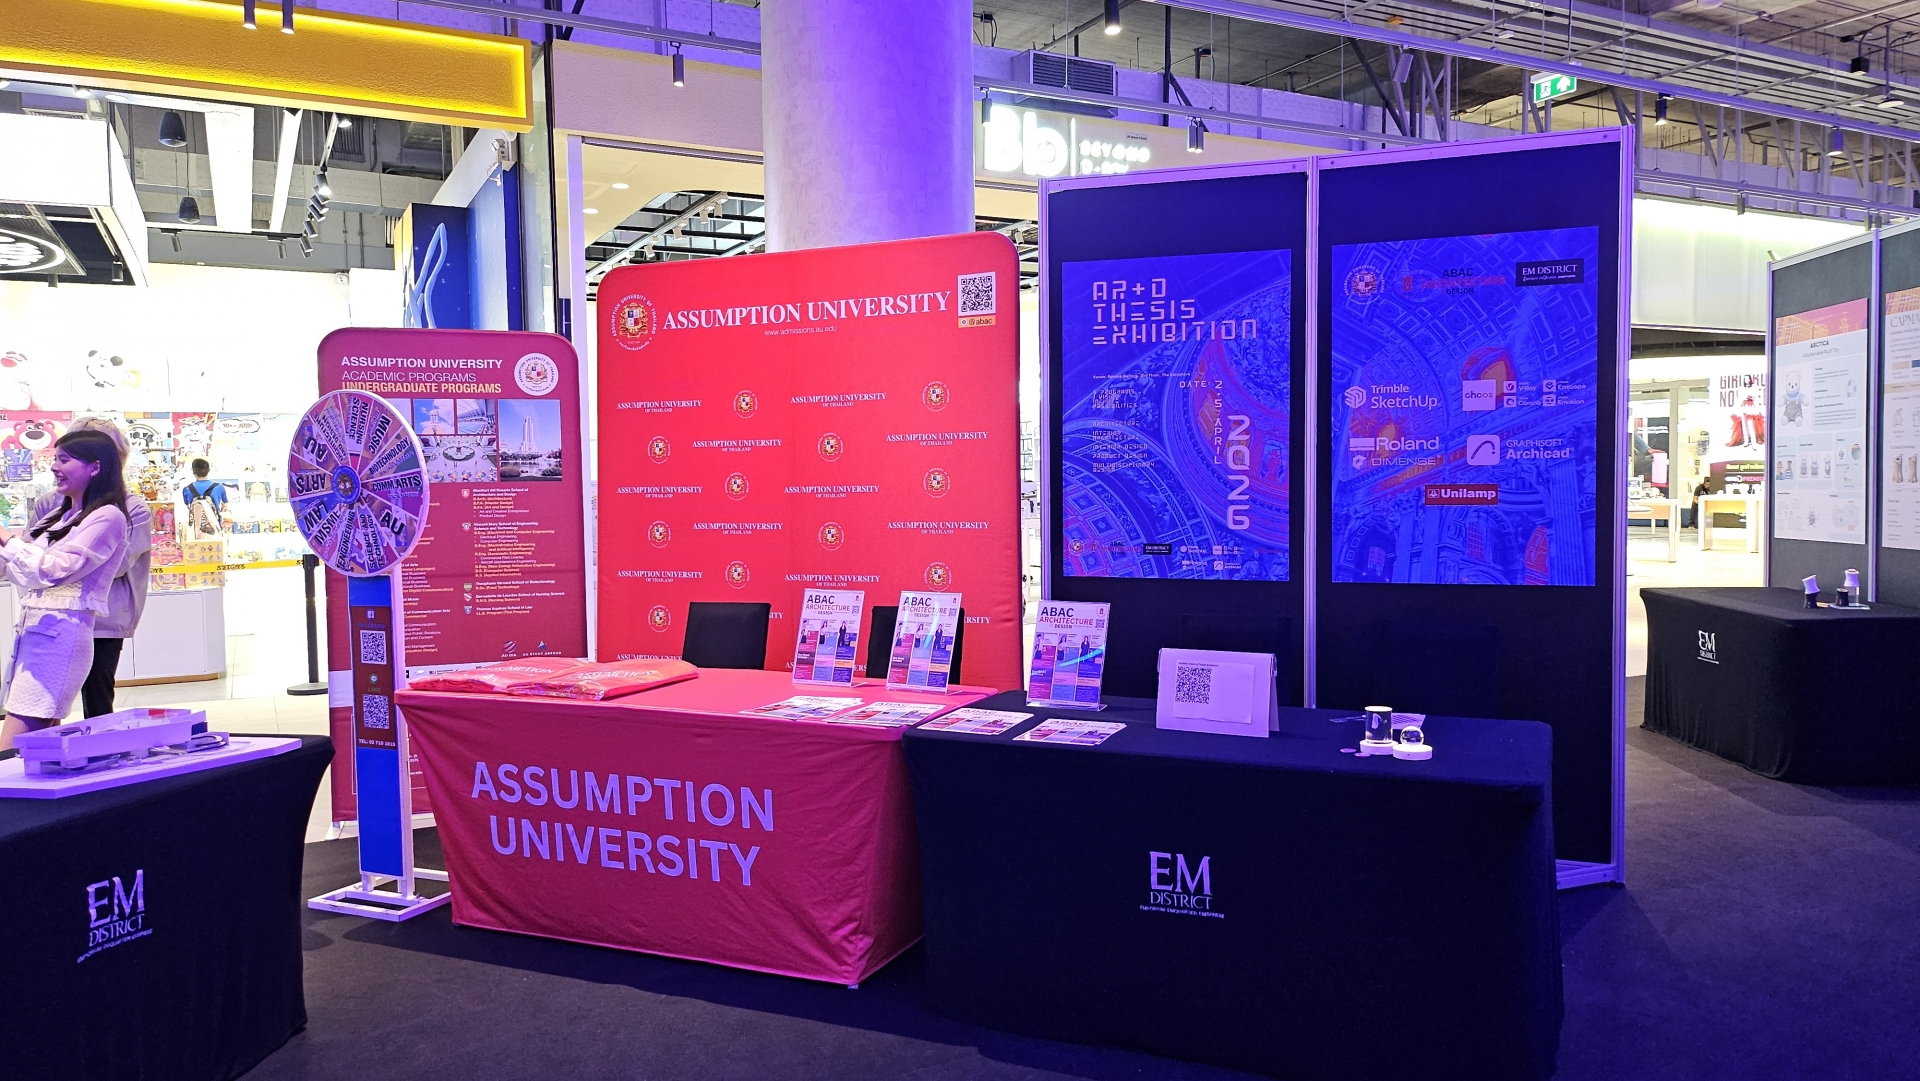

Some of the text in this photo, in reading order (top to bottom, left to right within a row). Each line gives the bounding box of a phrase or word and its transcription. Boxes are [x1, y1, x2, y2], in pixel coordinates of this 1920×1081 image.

[1442, 268, 1474, 278] ABAC
[1522, 264, 1578, 275] EM DISTRICT
[662, 290, 951, 330] ASSUMPTION UNIVERSITY
[1092, 298, 1196, 322] THESIS
[969, 318, 992, 326] @abac
[764, 325, 837, 336] www.admissions.au.edu
[1092, 318, 1258, 344] EXHIBITION
[1810, 340, 1829, 348] ARCTICA
[341, 357, 503, 369] ASSUMPTION UNIVERSITY
[342, 371, 476, 382] ACADEMIC PROGRAMS
[342, 382, 502, 393] UNDERGRADUATE PROGRAMS
[1371, 384, 1409, 394] Trimble
[790, 392, 886, 404] ASSUMPTION UNIVERSITY
[1371, 395, 1438, 410] SketchUp
[616, 400, 702, 410] ASSUMPTION UNIVERSITY
[350, 397, 361, 440] SCIENCE
[356, 402, 369, 444] NURSING
[368, 413, 392, 454] MUSIC
[886, 432, 988, 442] ASSUMPTION UNIVERSITY
[738, 439, 782, 447] UNIVERSITY
[1376, 436, 1440, 450] Roland
[1506, 438, 1563, 448] GRAPHISOFT
[369, 437, 410, 475] BIOTECHNOLOGY
[1506, 448, 1570, 460] Archicad
[1372, 457, 1436, 466] DIMENSE
[1226, 414, 1250, 530] 2026
[296, 473, 326, 494] ARTS
[784, 486, 832, 494] ASSUMPTION
[1440, 488, 1496, 500] Unilamp
[305, 500, 330, 532] LAW
[380, 510, 405, 535] AU
[887, 521, 938, 529] ASSUMPTION
[366, 514, 384, 567] TECHNOLOGY
[364, 532, 375, 569] SCIENCE
[785, 574, 880, 583] ASSUMPTION UNIVERSITY
[806, 595, 835, 604] ABAC
[903, 596, 932, 606] ABAC
[805, 604, 850, 612] ARCHITECTURE
[902, 606, 947, 614] ARCHITECTURE
[1040, 606, 1074, 618] ABAC
[1039, 617, 1093, 626] ARCHITECTURE
[1698, 630, 1716, 652] EM
[471, 761, 774, 832] ASSUMPTION
[490, 814, 760, 886] UNIVERSITY
[1149, 851, 1212, 896] EM
[86, 869, 145, 928] EM
[1150, 892, 1212, 910] DISTRICT
[89, 913, 145, 947] DISTRICT
